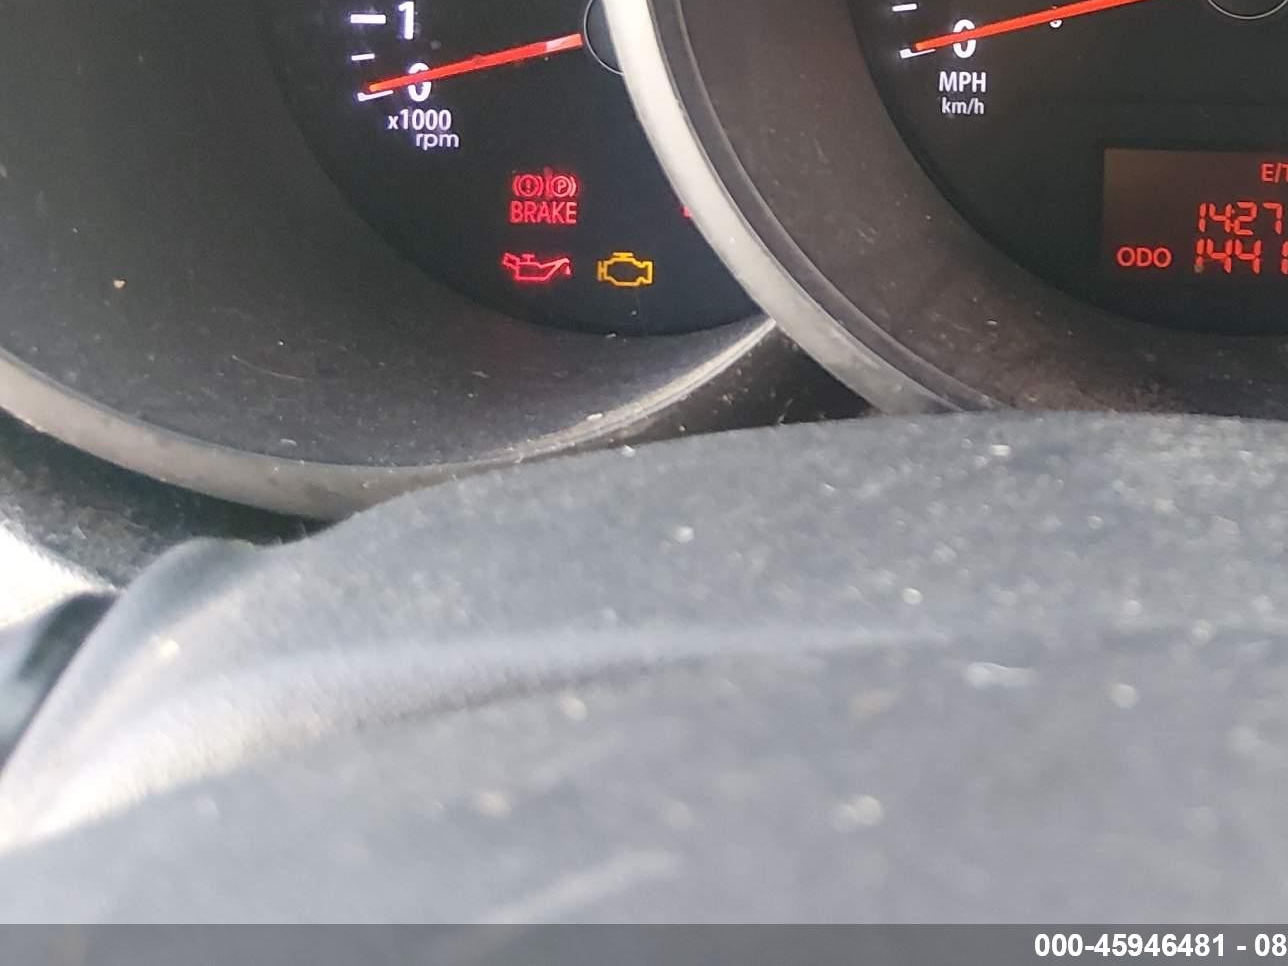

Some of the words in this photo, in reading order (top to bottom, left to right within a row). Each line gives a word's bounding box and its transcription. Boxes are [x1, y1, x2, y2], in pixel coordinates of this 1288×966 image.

[398, 1, 417, 39] 1
[953, 19, 977, 59] 0
[408, 63, 432, 102] 0
[939, 71, 986, 92] MPH
[942, 97, 984, 114] km/h
[388, 109, 451, 131] x1000
[416, 132, 459, 150] rpm
[510, 201, 577, 223] BRAKE
[1116, 246, 1172, 268] ODO
